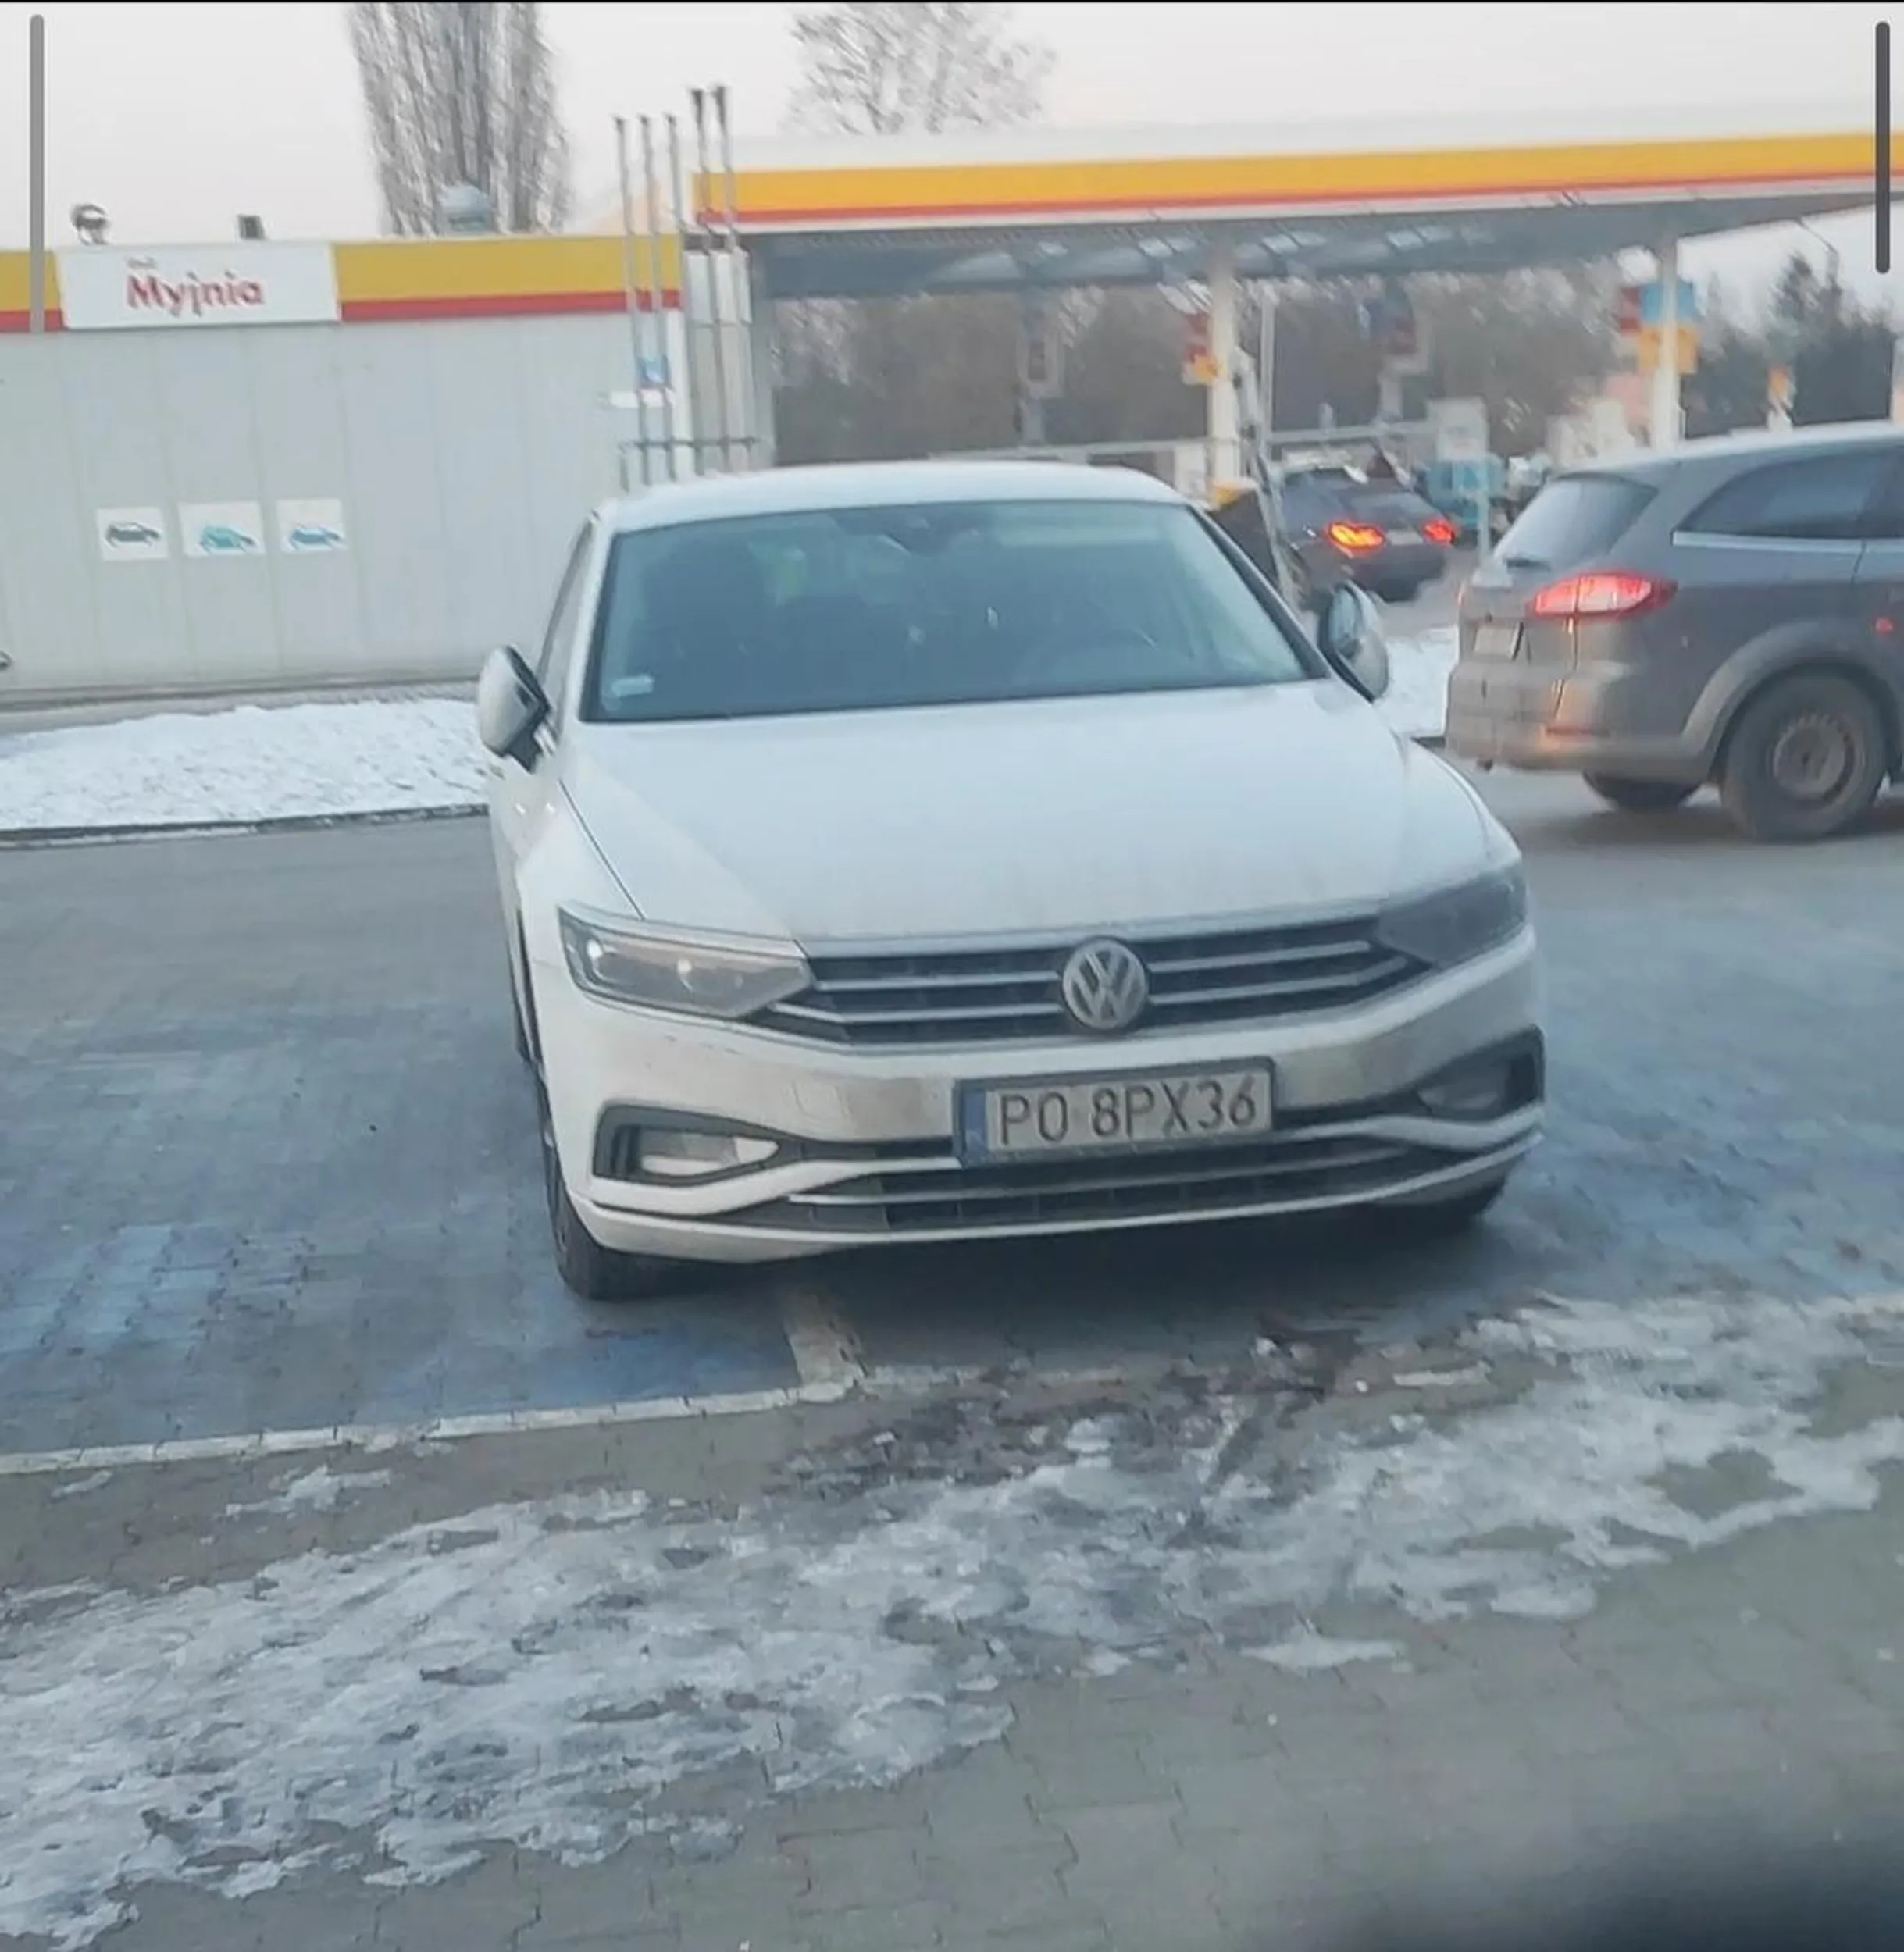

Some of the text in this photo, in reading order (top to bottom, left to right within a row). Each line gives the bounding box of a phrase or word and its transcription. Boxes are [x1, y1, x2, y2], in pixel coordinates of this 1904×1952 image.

[127, 271, 264, 318] Myjnia
[1000, 1074, 1257, 1145] PO 8PX36
